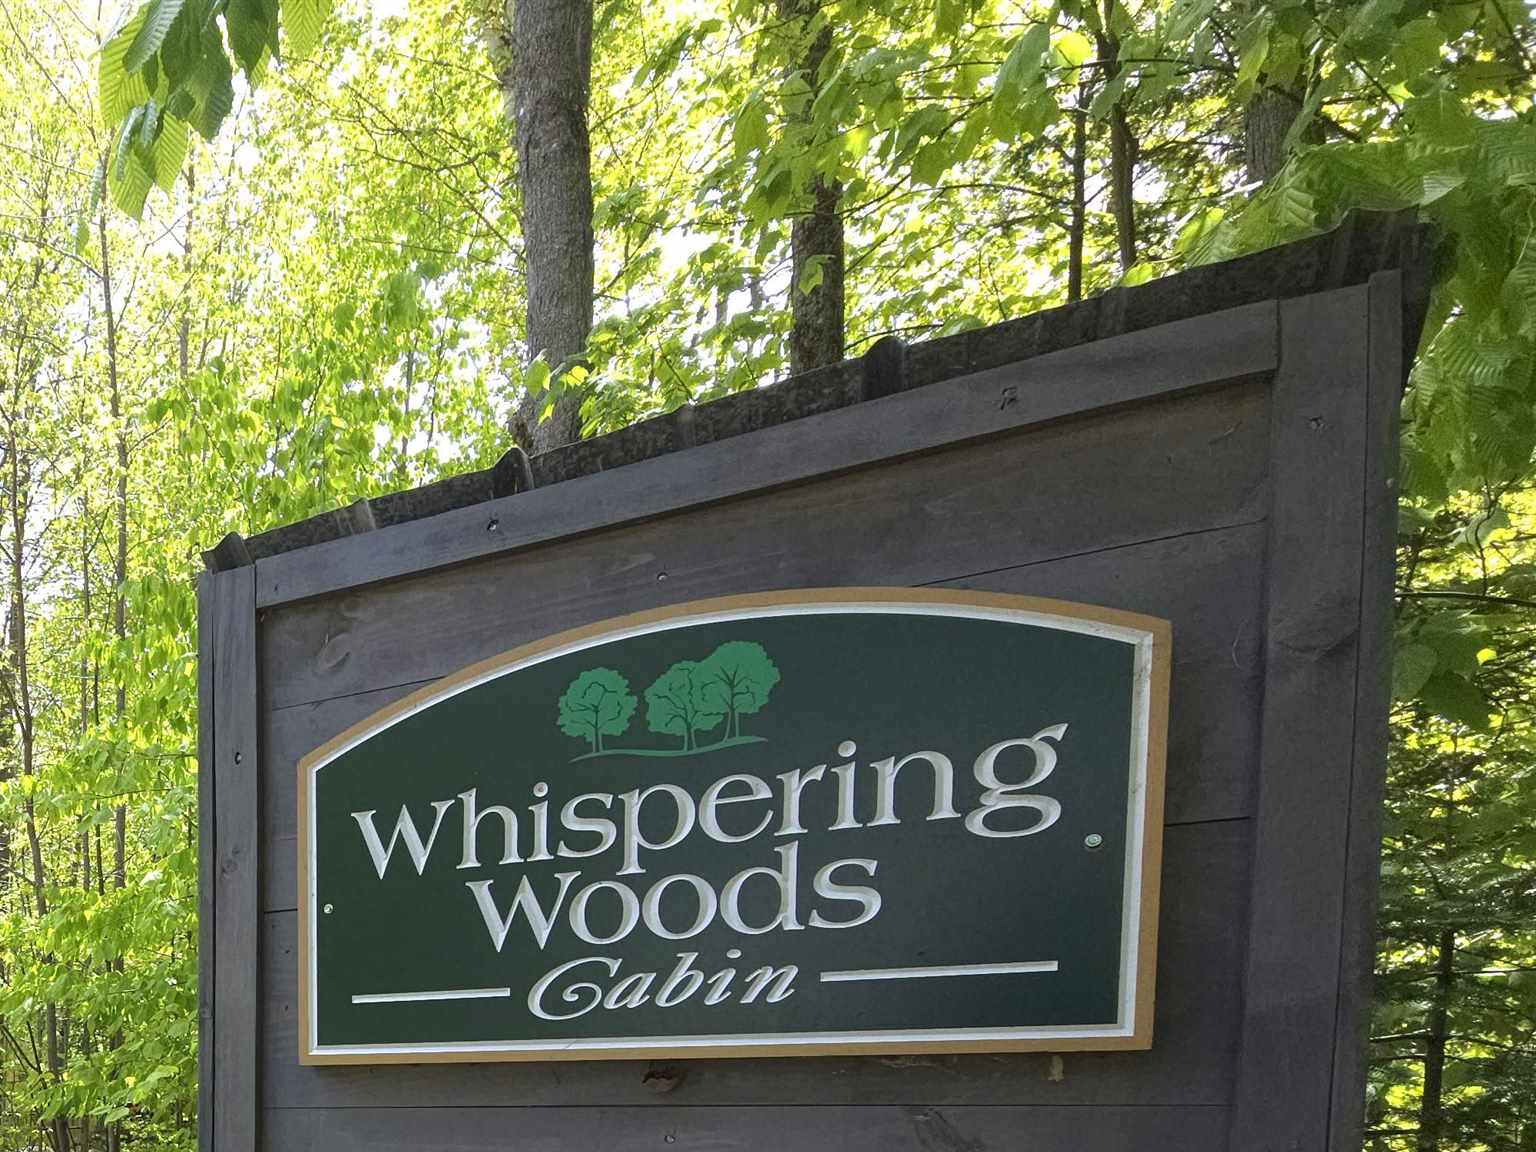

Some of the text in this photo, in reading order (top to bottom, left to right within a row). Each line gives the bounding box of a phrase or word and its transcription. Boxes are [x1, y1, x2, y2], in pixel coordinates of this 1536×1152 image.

[351, 723, 1069, 879] Whispering
[466, 842, 882, 952] Woods
[527, 949, 799, 1021] Cabin
